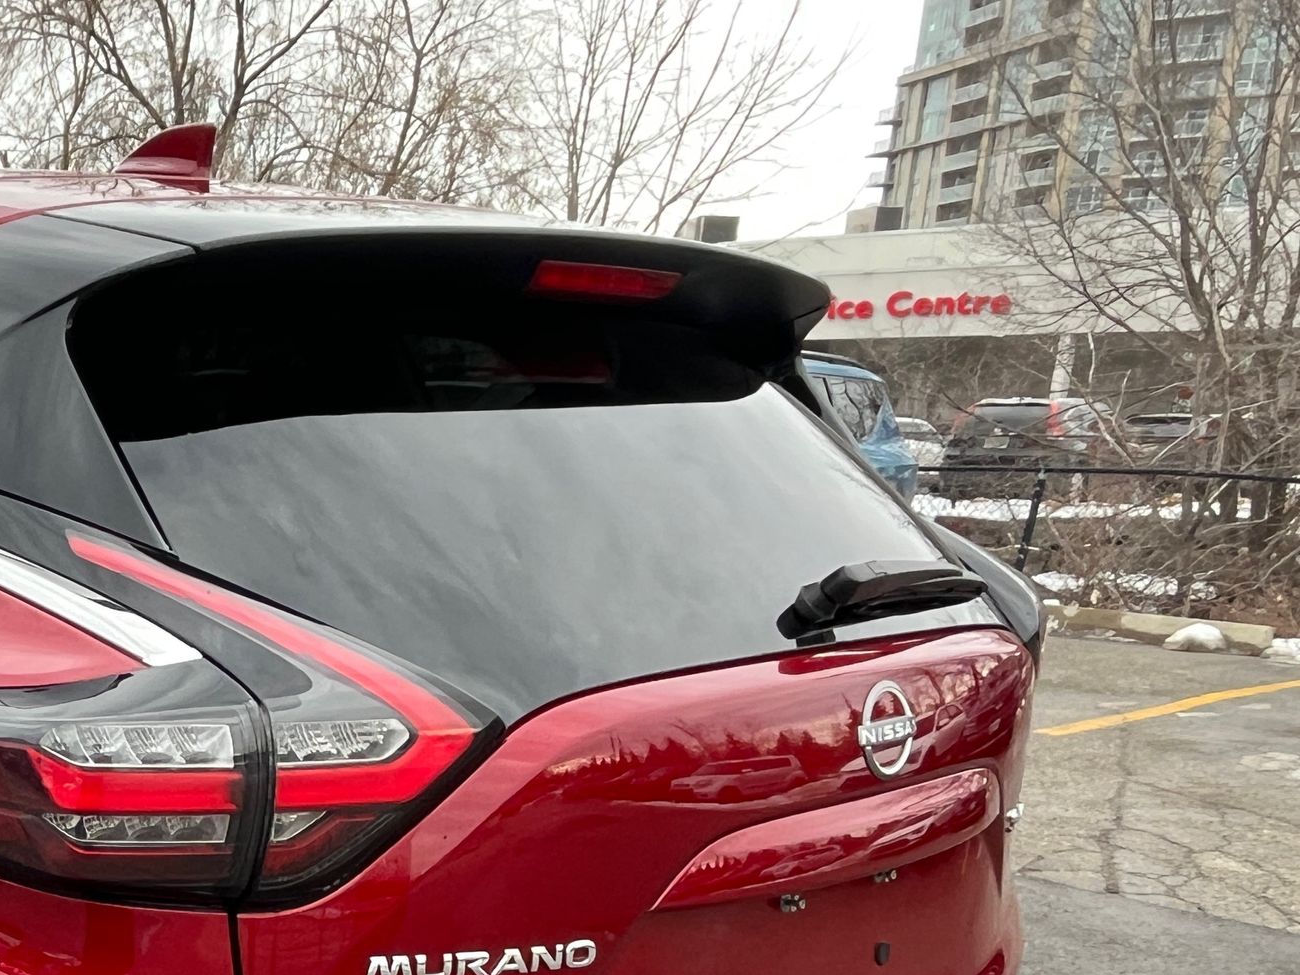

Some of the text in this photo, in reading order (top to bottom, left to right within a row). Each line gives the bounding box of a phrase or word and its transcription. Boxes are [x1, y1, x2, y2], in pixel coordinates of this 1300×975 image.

[827, 291, 1012, 320] ice Centre
[860, 720, 915, 745] NISSA
